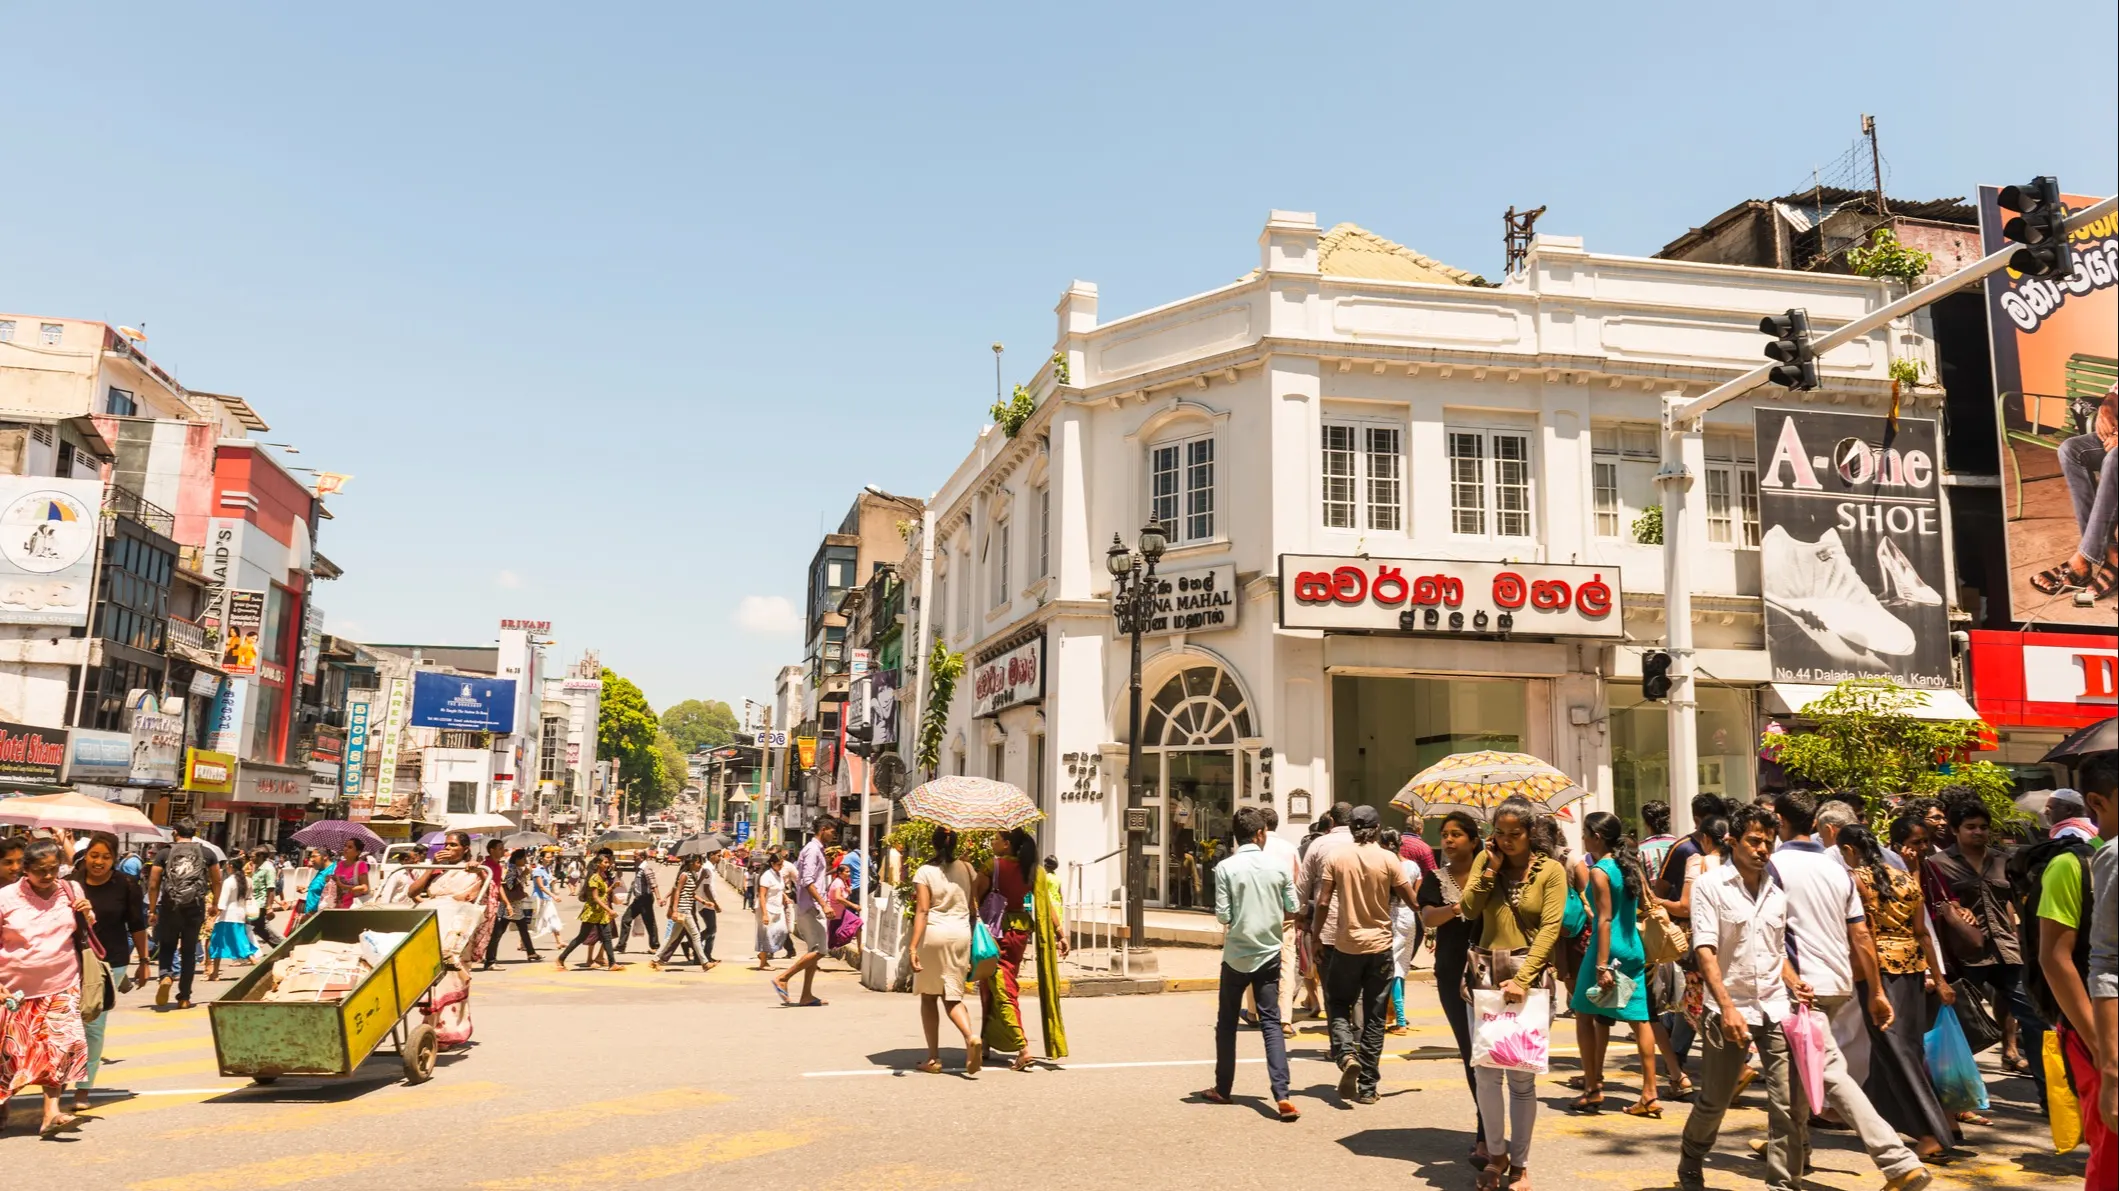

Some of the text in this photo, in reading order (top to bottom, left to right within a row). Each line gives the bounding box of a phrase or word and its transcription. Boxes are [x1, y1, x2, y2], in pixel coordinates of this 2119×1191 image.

[1761, 415, 1933, 490] A-One
[1836, 502, 1938, 535] SHOE
[1176, 591, 1232, 611] MAHAL
[1492, 571, 1613, 617] මහල්
[1775, 667, 1811, 680] No.44
[1814, 668, 1855, 681] Dalada
[1910, 673, 1950, 688] Kandy.
[27, 733, 65, 766] Shams
[376, 680, 404, 804] SAREE KINGDOM
[1074, 776, 1091, 790] 46
